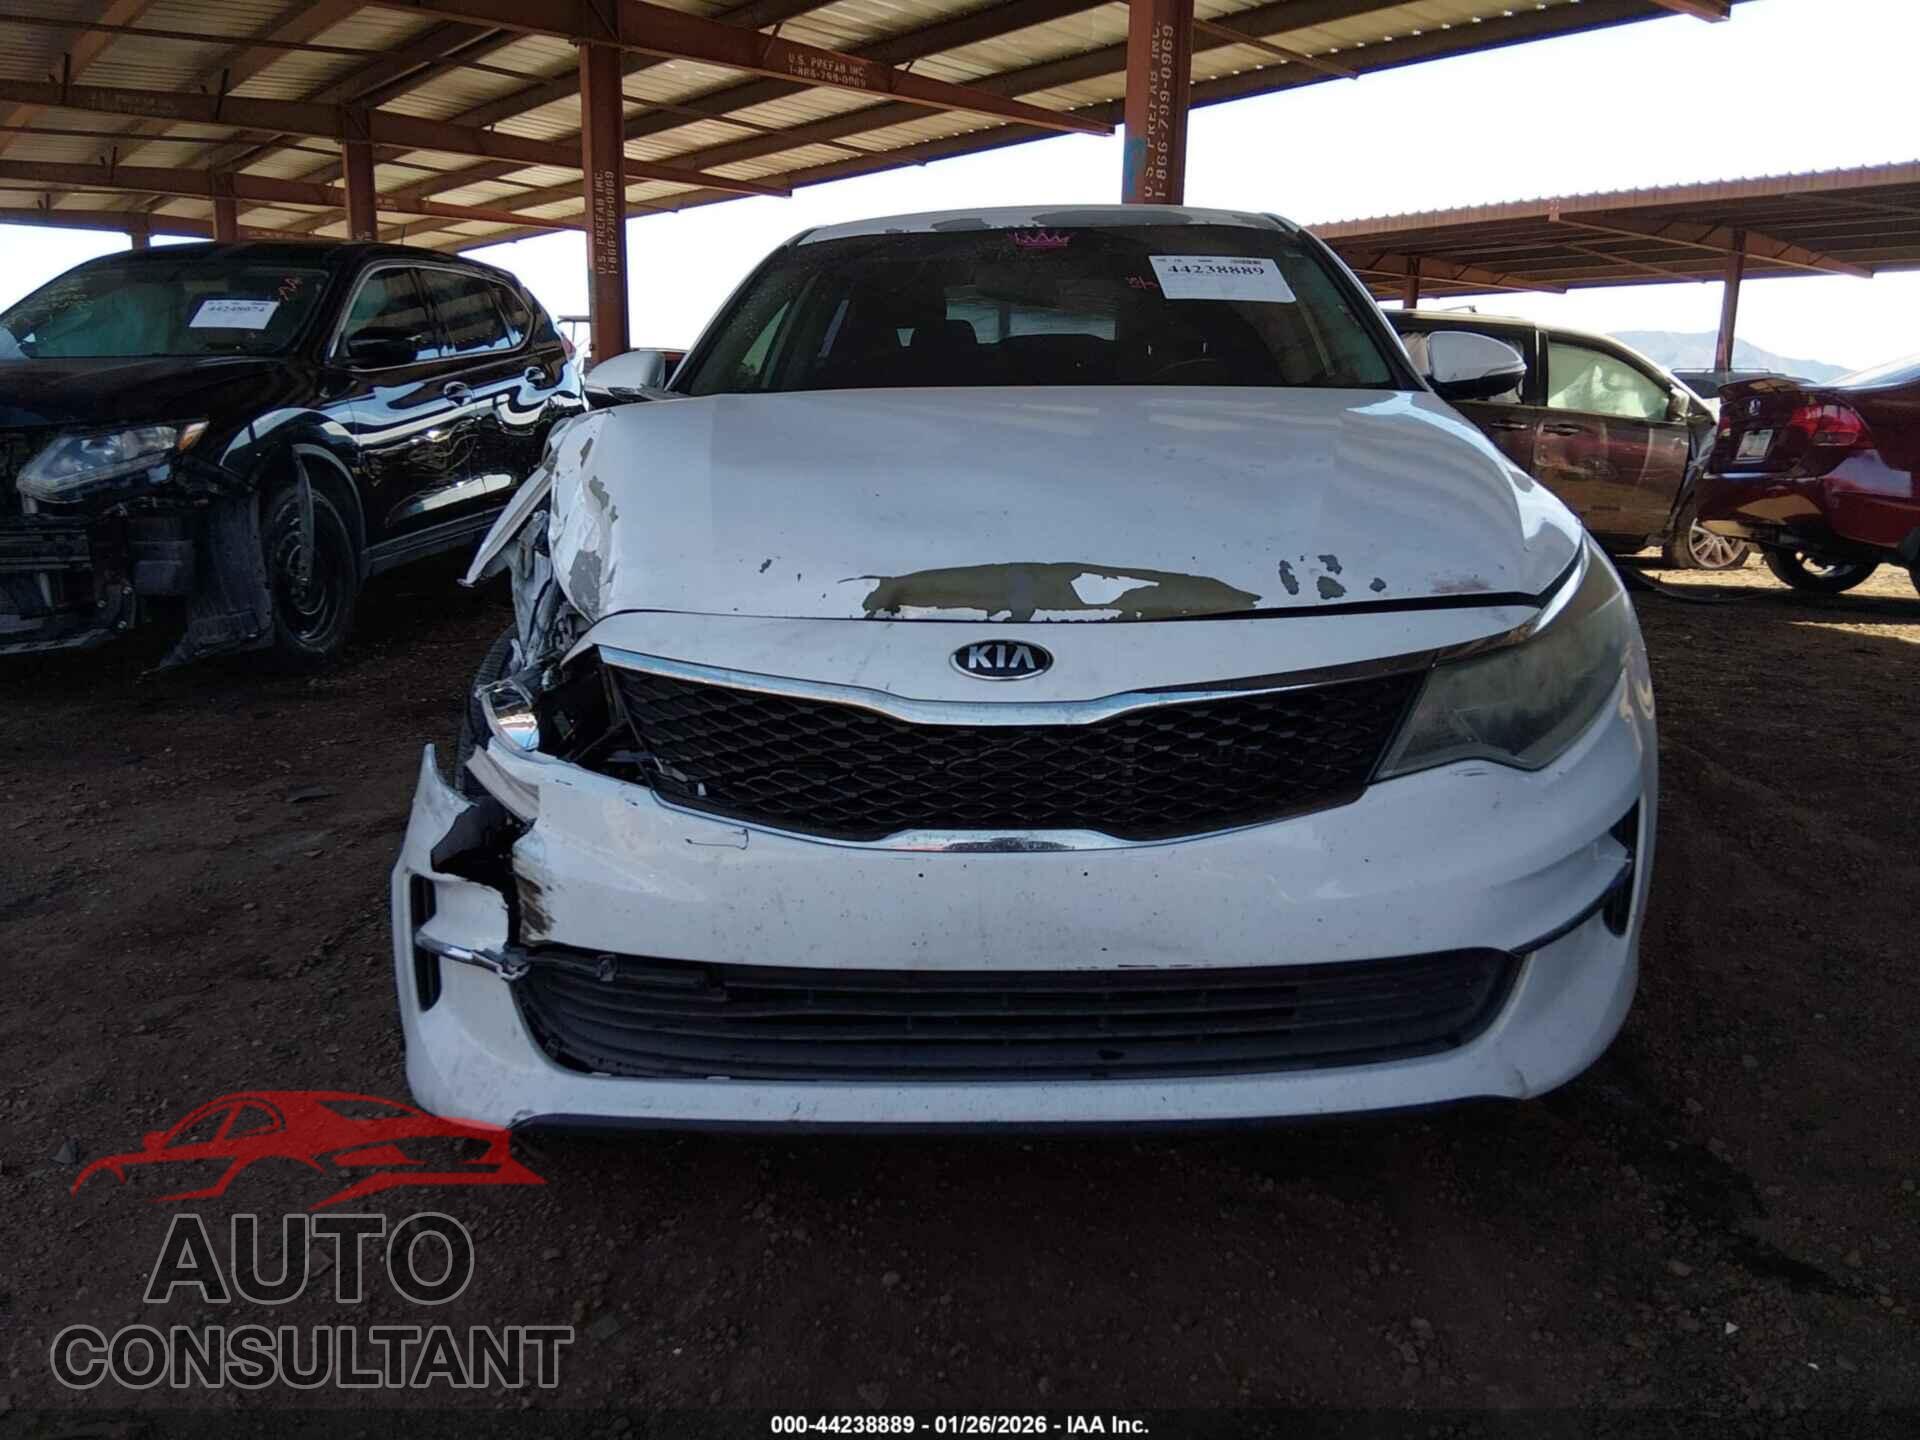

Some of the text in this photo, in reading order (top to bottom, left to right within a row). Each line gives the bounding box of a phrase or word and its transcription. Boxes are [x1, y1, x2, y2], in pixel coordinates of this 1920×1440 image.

[1146, 71, 1159, 149] PREFAB
[1155, 24, 1174, 198] 1-866-799-0969
[1167, 264, 1265, 275] 44238889
[968, 644, 1037, 669] KIA
